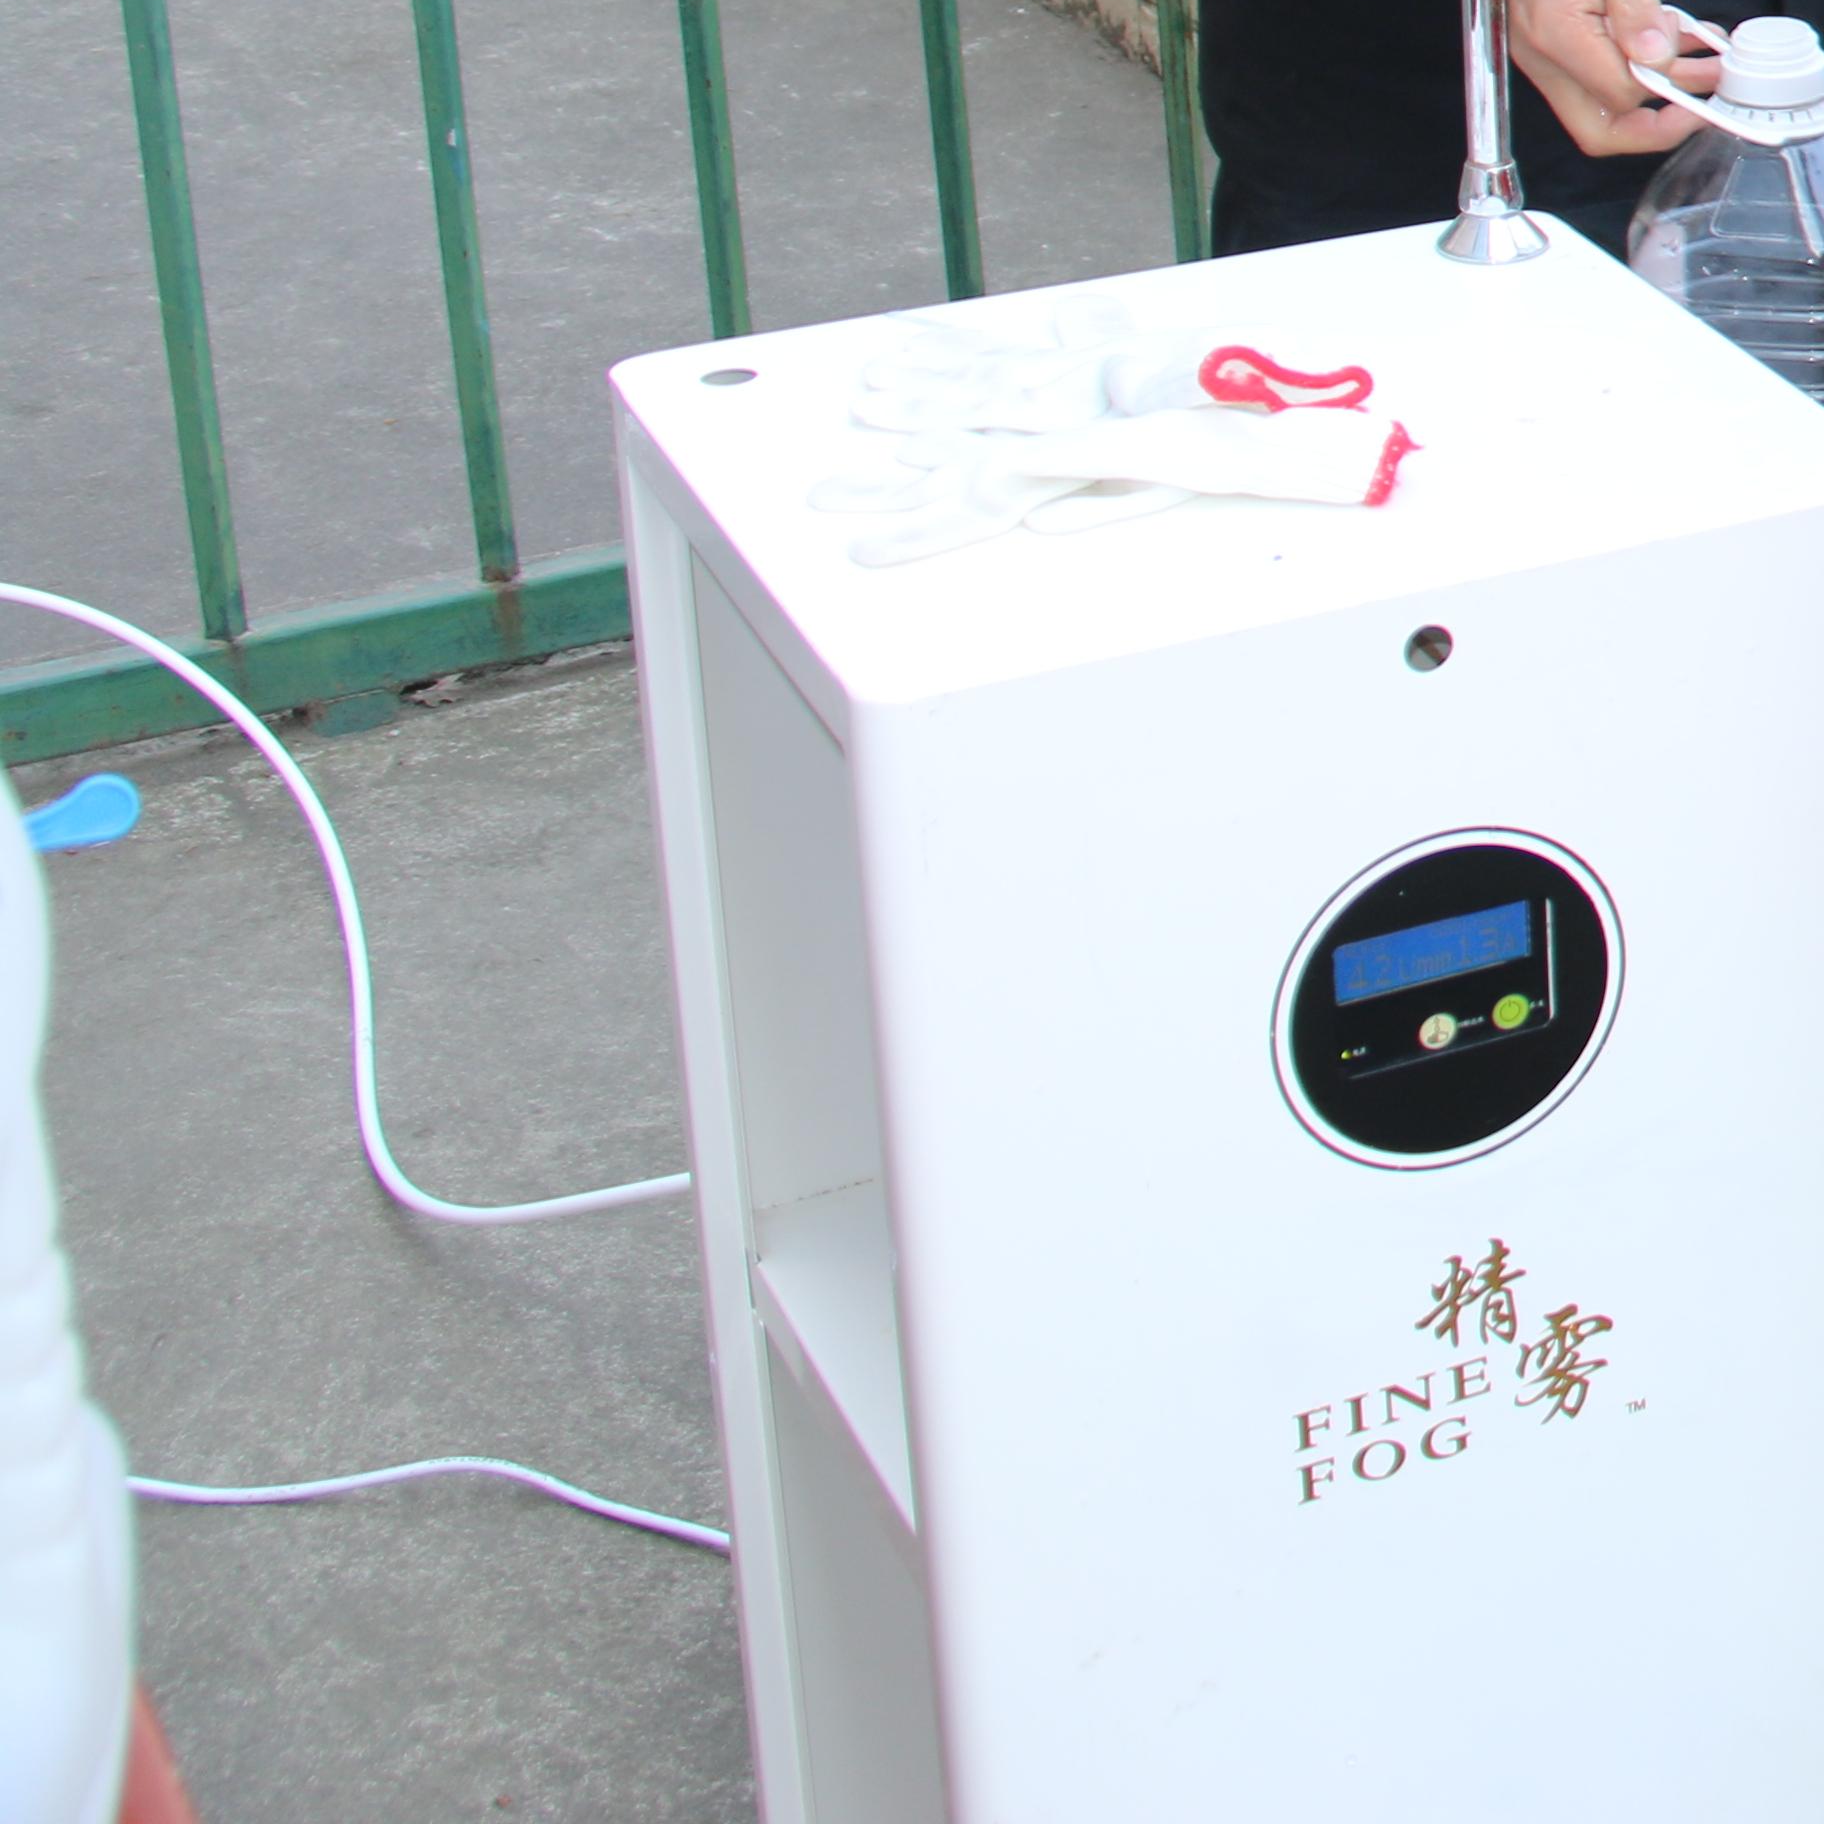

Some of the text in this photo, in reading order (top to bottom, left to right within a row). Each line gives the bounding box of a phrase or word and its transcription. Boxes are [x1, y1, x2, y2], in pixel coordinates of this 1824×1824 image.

[1415, 1237, 1613, 1425] 精雾
[1293, 1356, 1492, 1453] FINE
[1296, 1415, 1472, 1506] FOG
